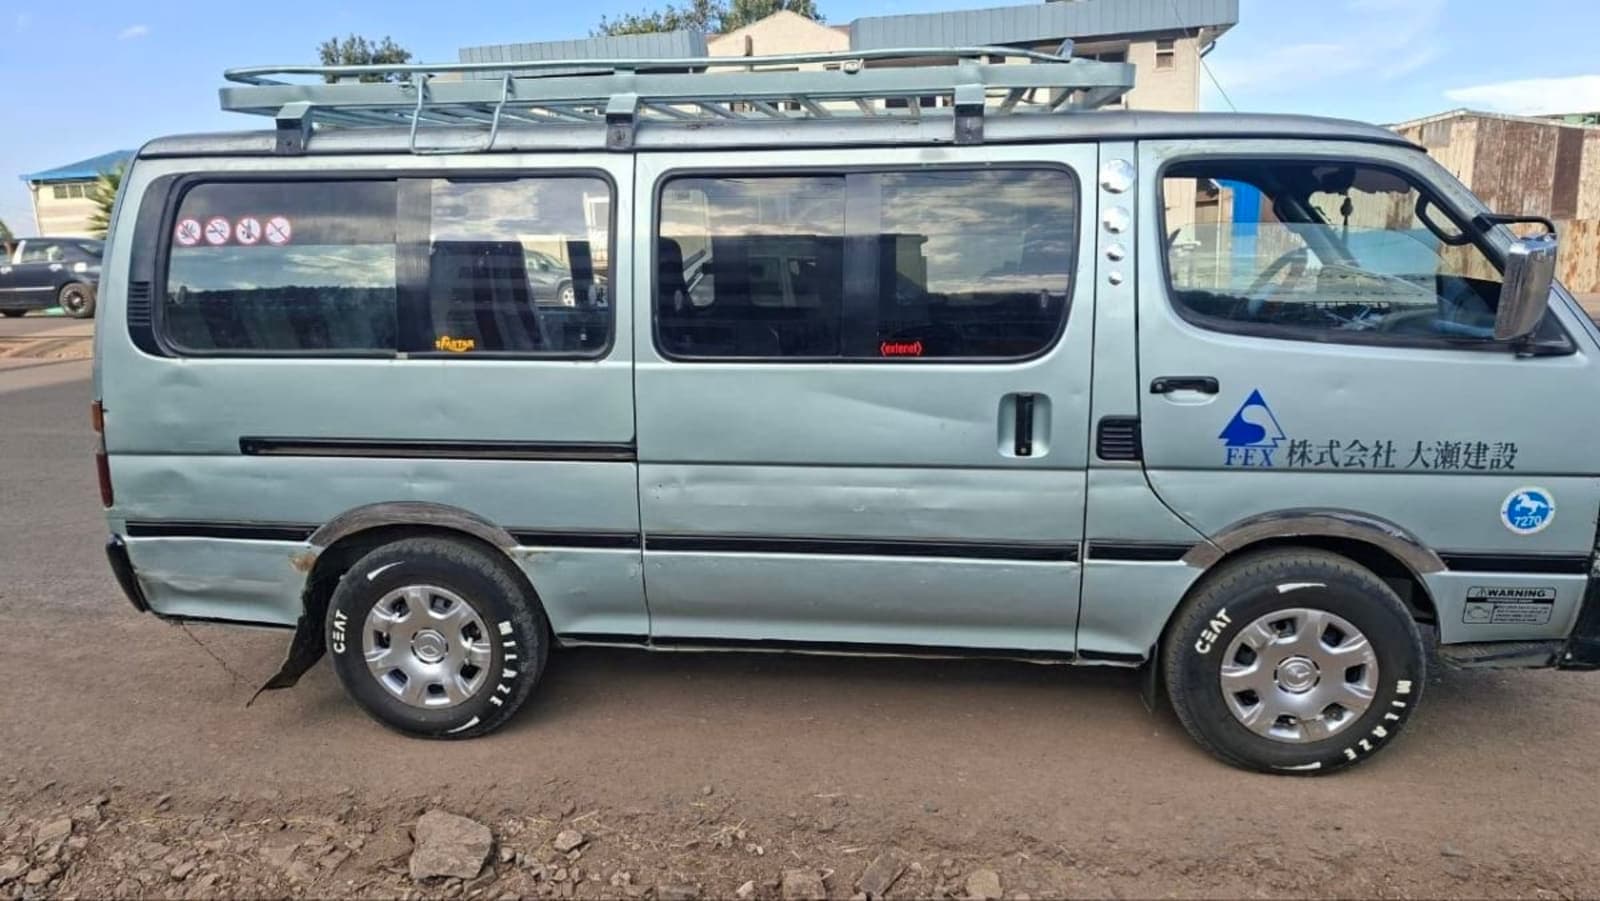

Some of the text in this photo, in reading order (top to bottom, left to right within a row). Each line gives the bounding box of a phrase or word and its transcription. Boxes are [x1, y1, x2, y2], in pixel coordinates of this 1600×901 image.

[1287, 439, 1518, 469] 株式会社 大瀬建設
[1514, 515, 1542, 527] 7270
[1488, 589, 1546, 597] WARNING
[490, 620, 517, 706] MILAZE
[1344, 680, 1412, 760] MILAZE
